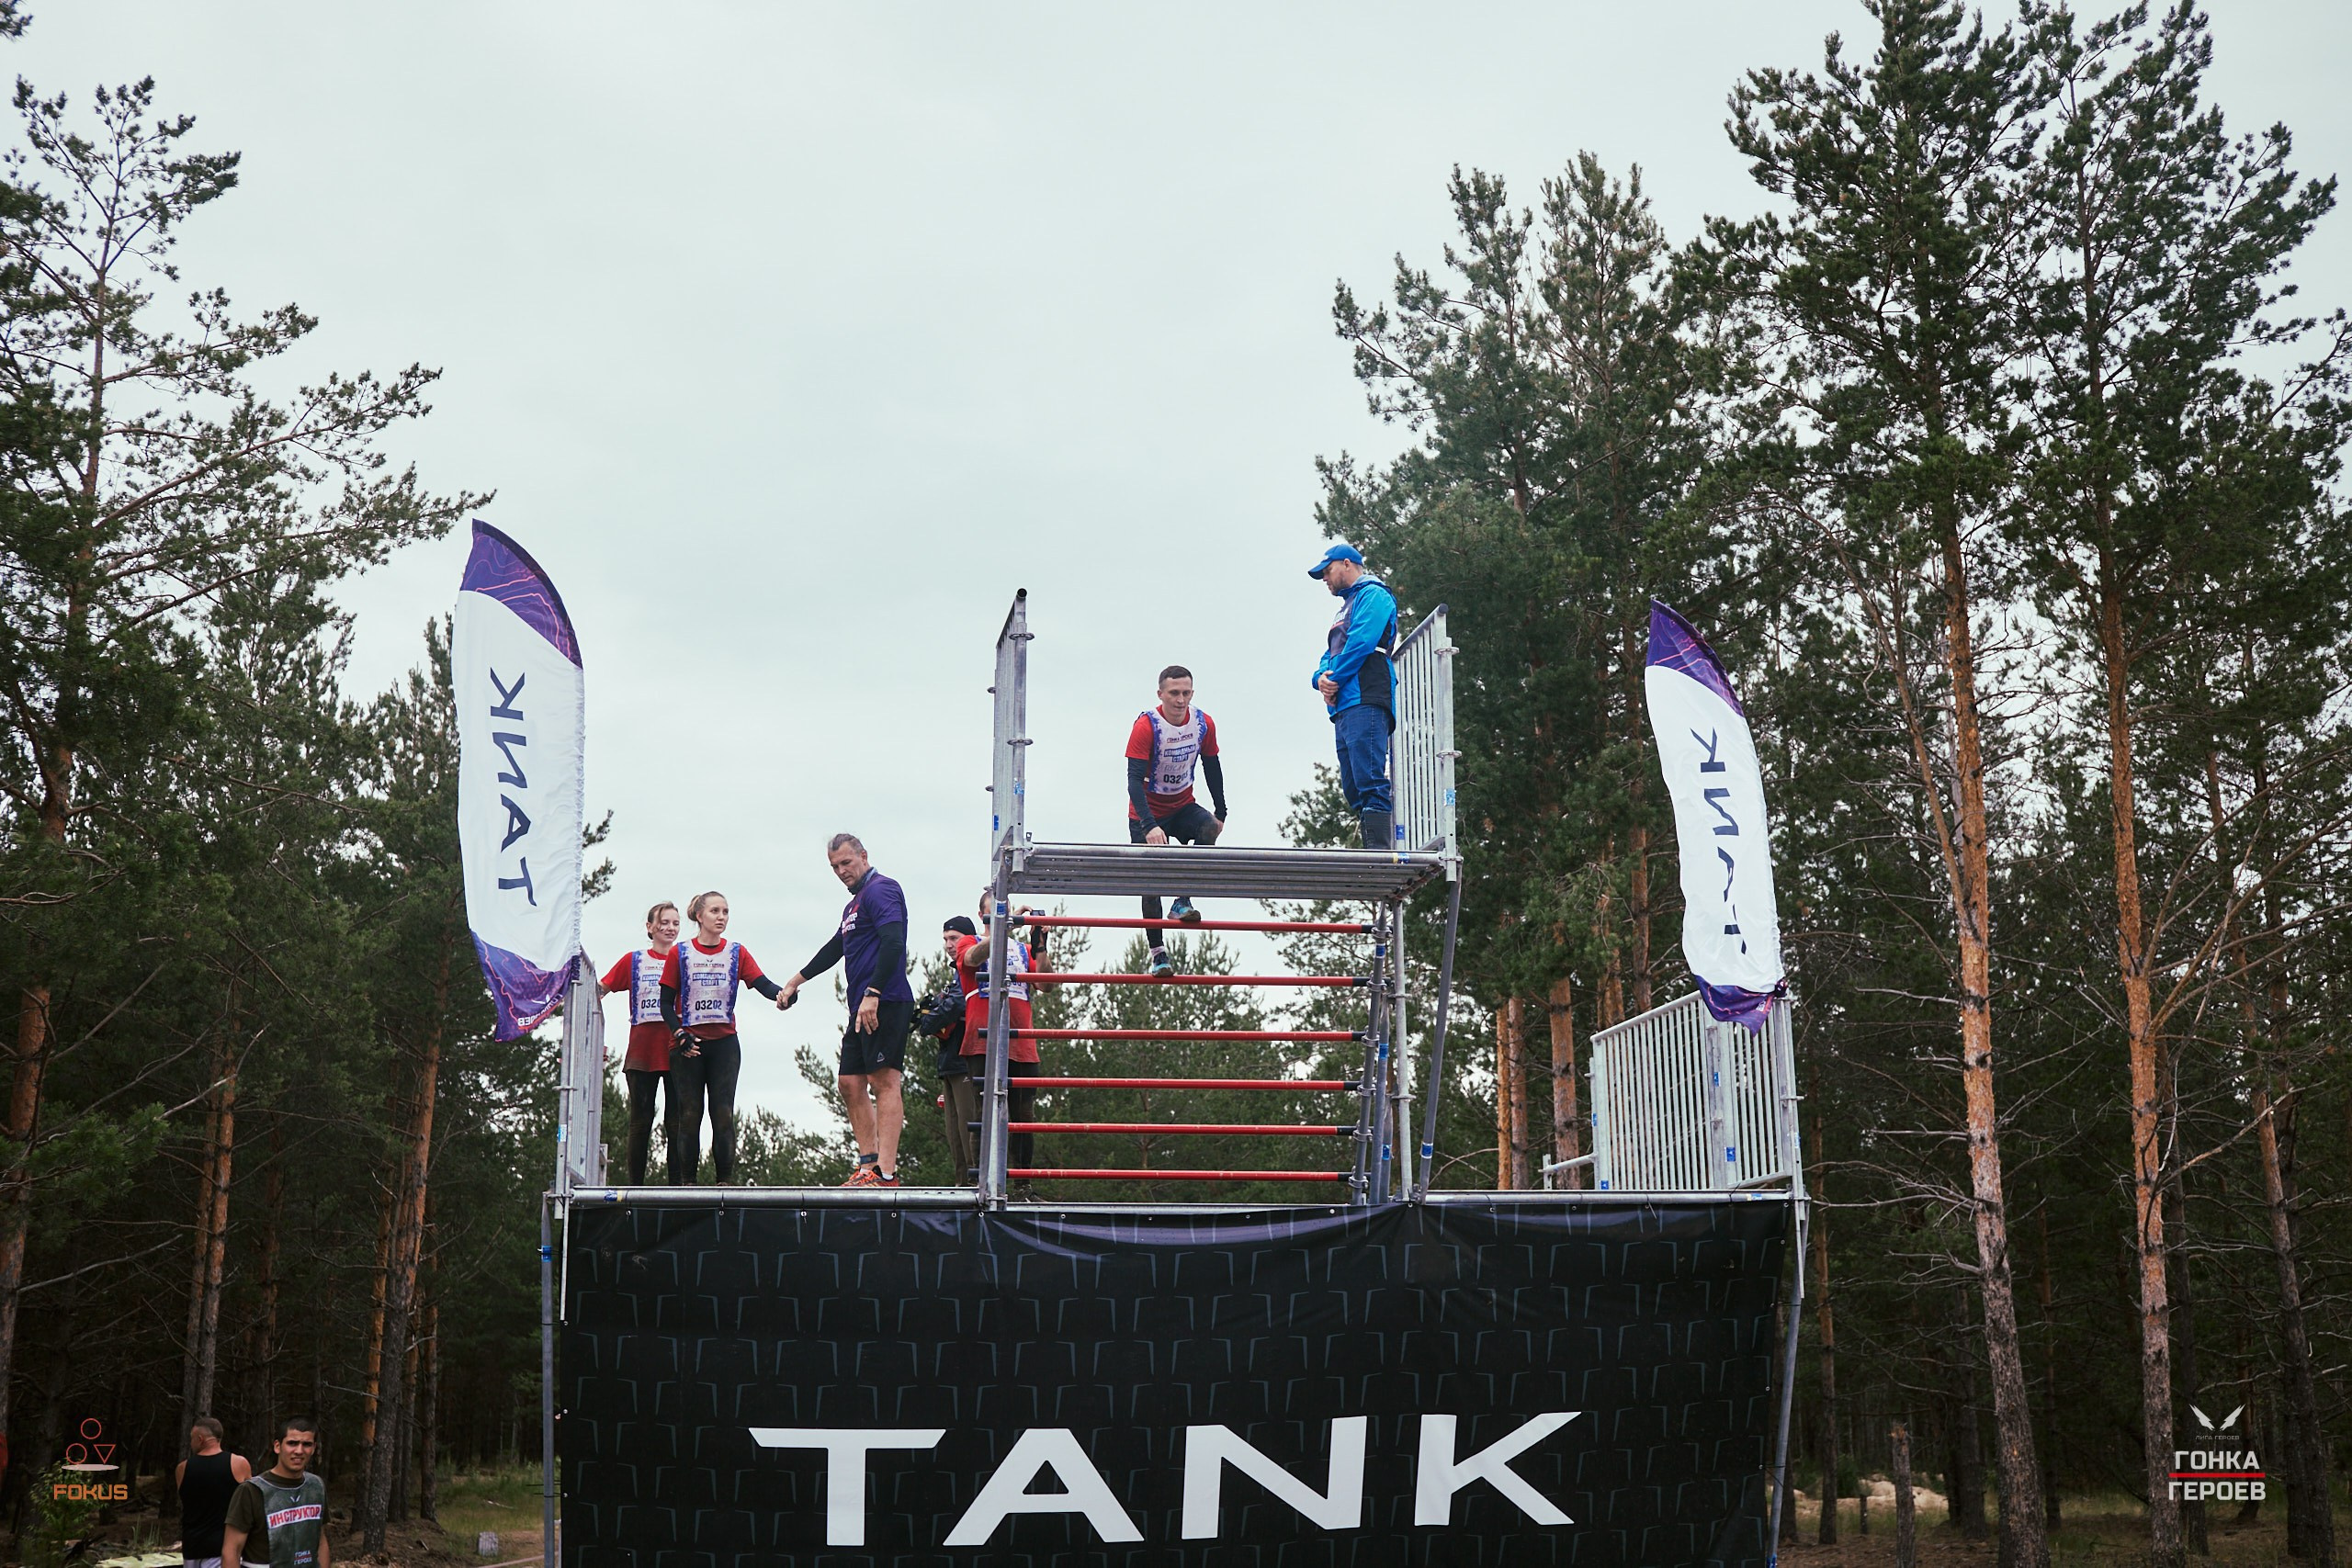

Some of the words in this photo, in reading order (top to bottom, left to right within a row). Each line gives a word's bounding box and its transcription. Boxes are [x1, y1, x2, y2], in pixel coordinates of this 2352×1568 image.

[695, 999, 722, 1011] 03202
[748, 1410, 1583, 1548] TANK
[269, 1506, 320, 1527] ИНСТРУКОР
